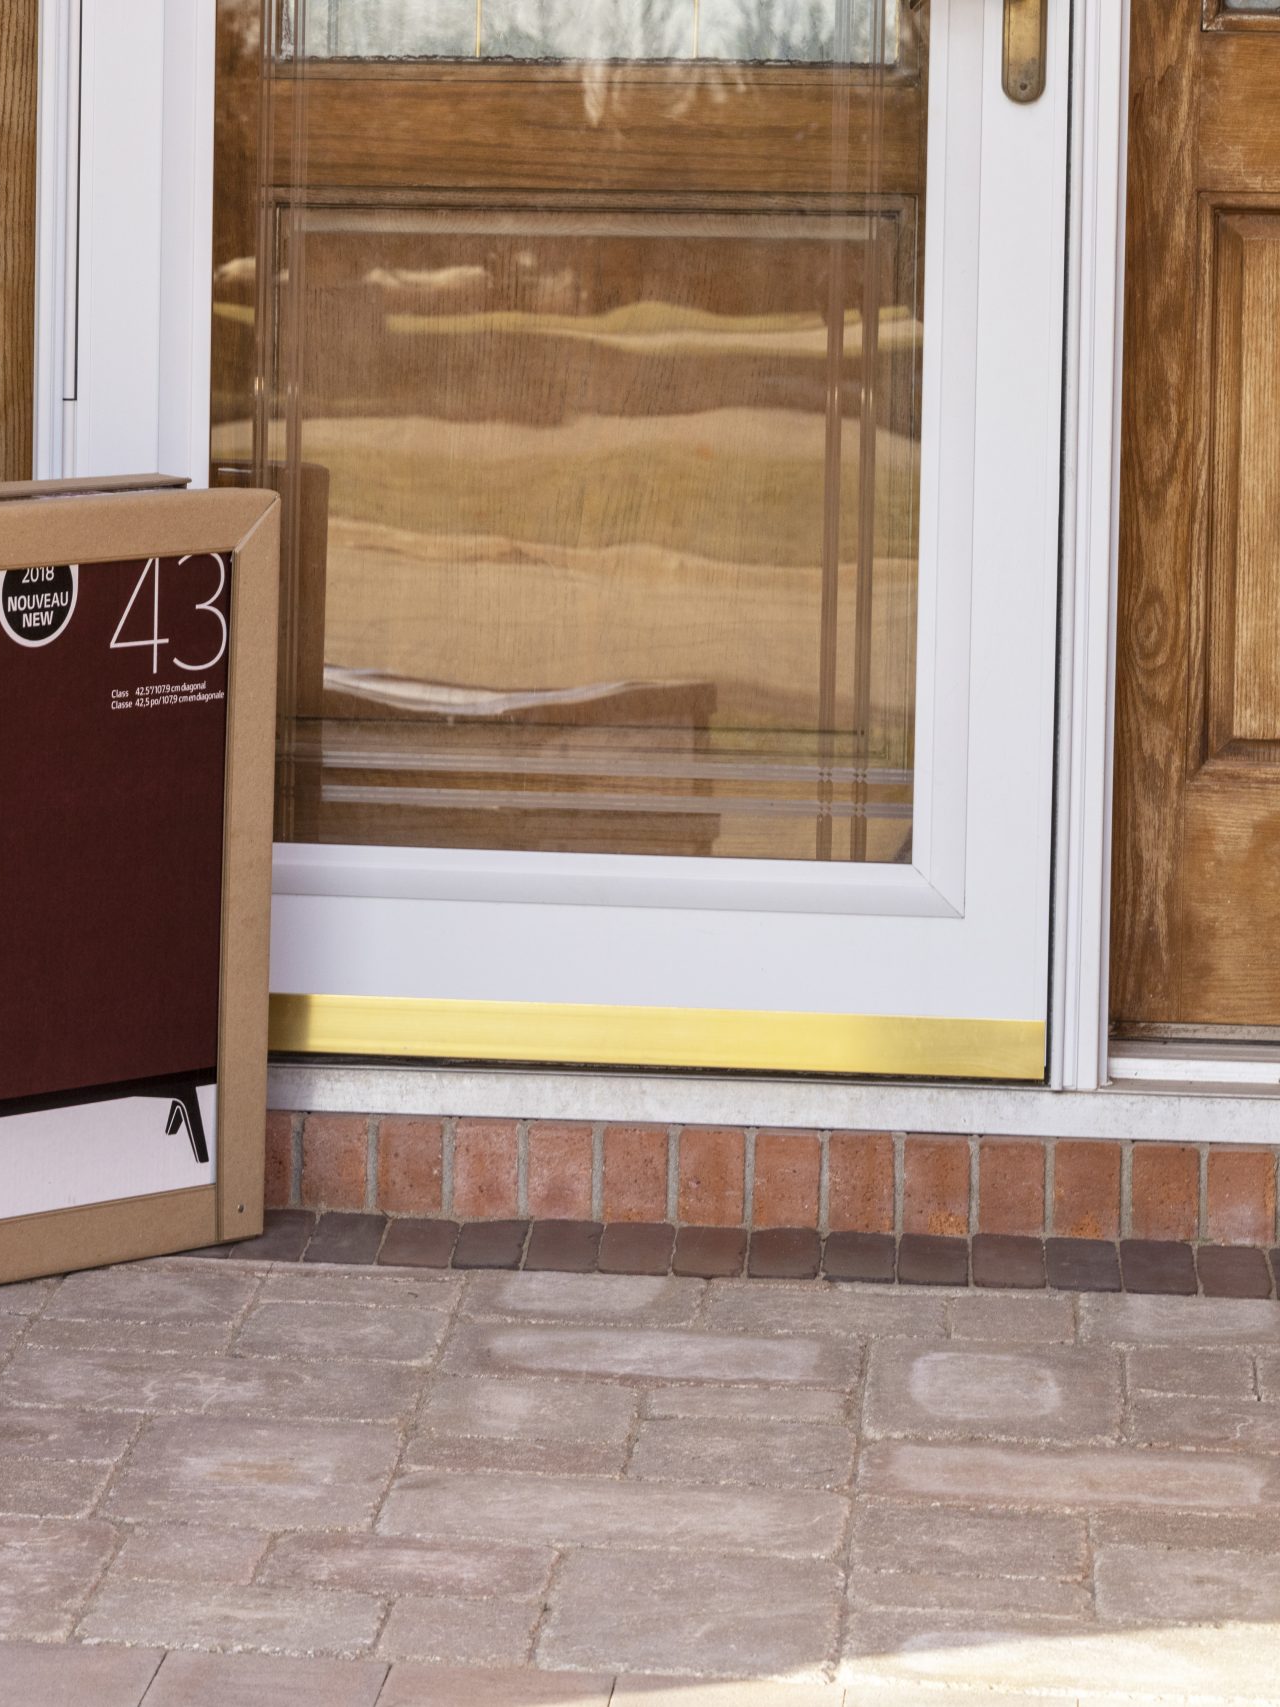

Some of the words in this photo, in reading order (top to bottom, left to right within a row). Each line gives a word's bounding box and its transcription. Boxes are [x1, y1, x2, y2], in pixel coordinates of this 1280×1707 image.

[21, 566, 55, 584] 2018
[7, 591, 69, 612] NOUVEAU
[22, 611, 54, 629] NEW
[111, 689, 129, 699] Class
[180, 680, 207, 693] diagonal
[111, 700, 133, 710] Classe
[197, 690, 225, 703] diagonale
